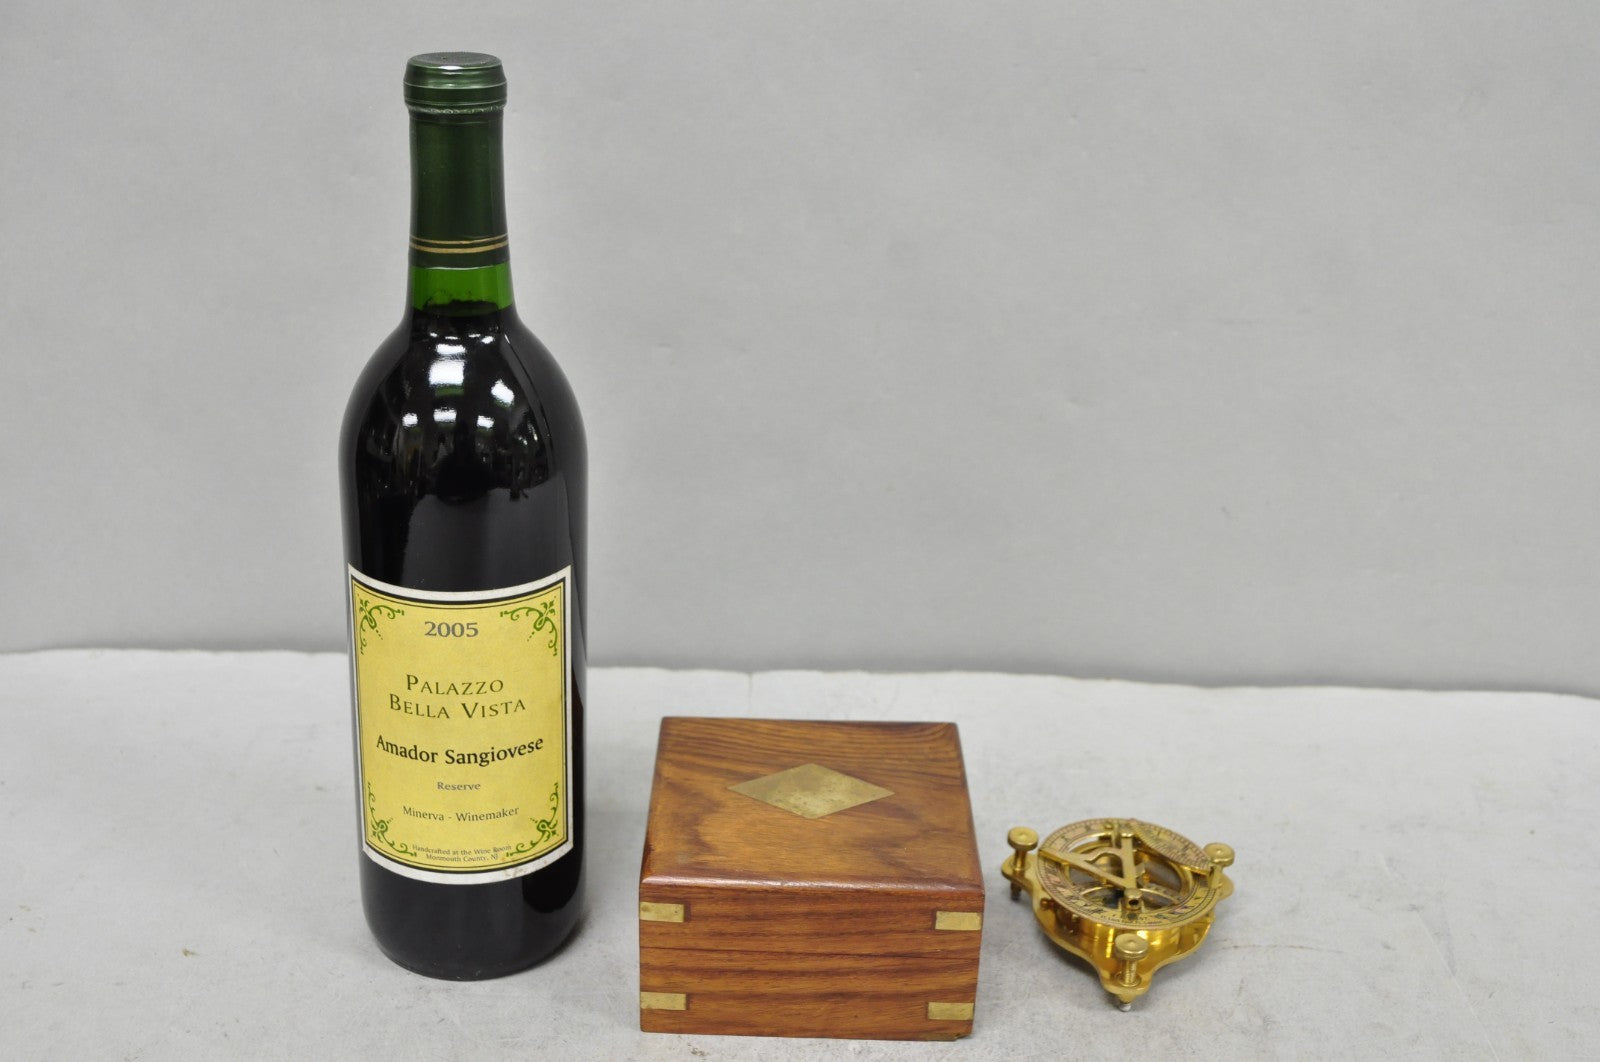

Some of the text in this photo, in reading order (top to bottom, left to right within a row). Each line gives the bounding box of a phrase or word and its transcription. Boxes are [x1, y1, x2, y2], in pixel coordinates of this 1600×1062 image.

[424, 621, 479, 637] 2005
[406, 674, 504, 695] PALAZZO
[389, 694, 526, 719] BELLA VISTA
[376, 735, 544, 767] Amador Sangiovese
[437, 782, 481, 791] Reserve
[402, 806, 445, 821] Minerva
[456, 807, 520, 822] Winemaker
[412, 844, 451, 855] Handcrafted
[493, 844, 512, 853] Room
[426, 854, 462, 862] Monmouth
